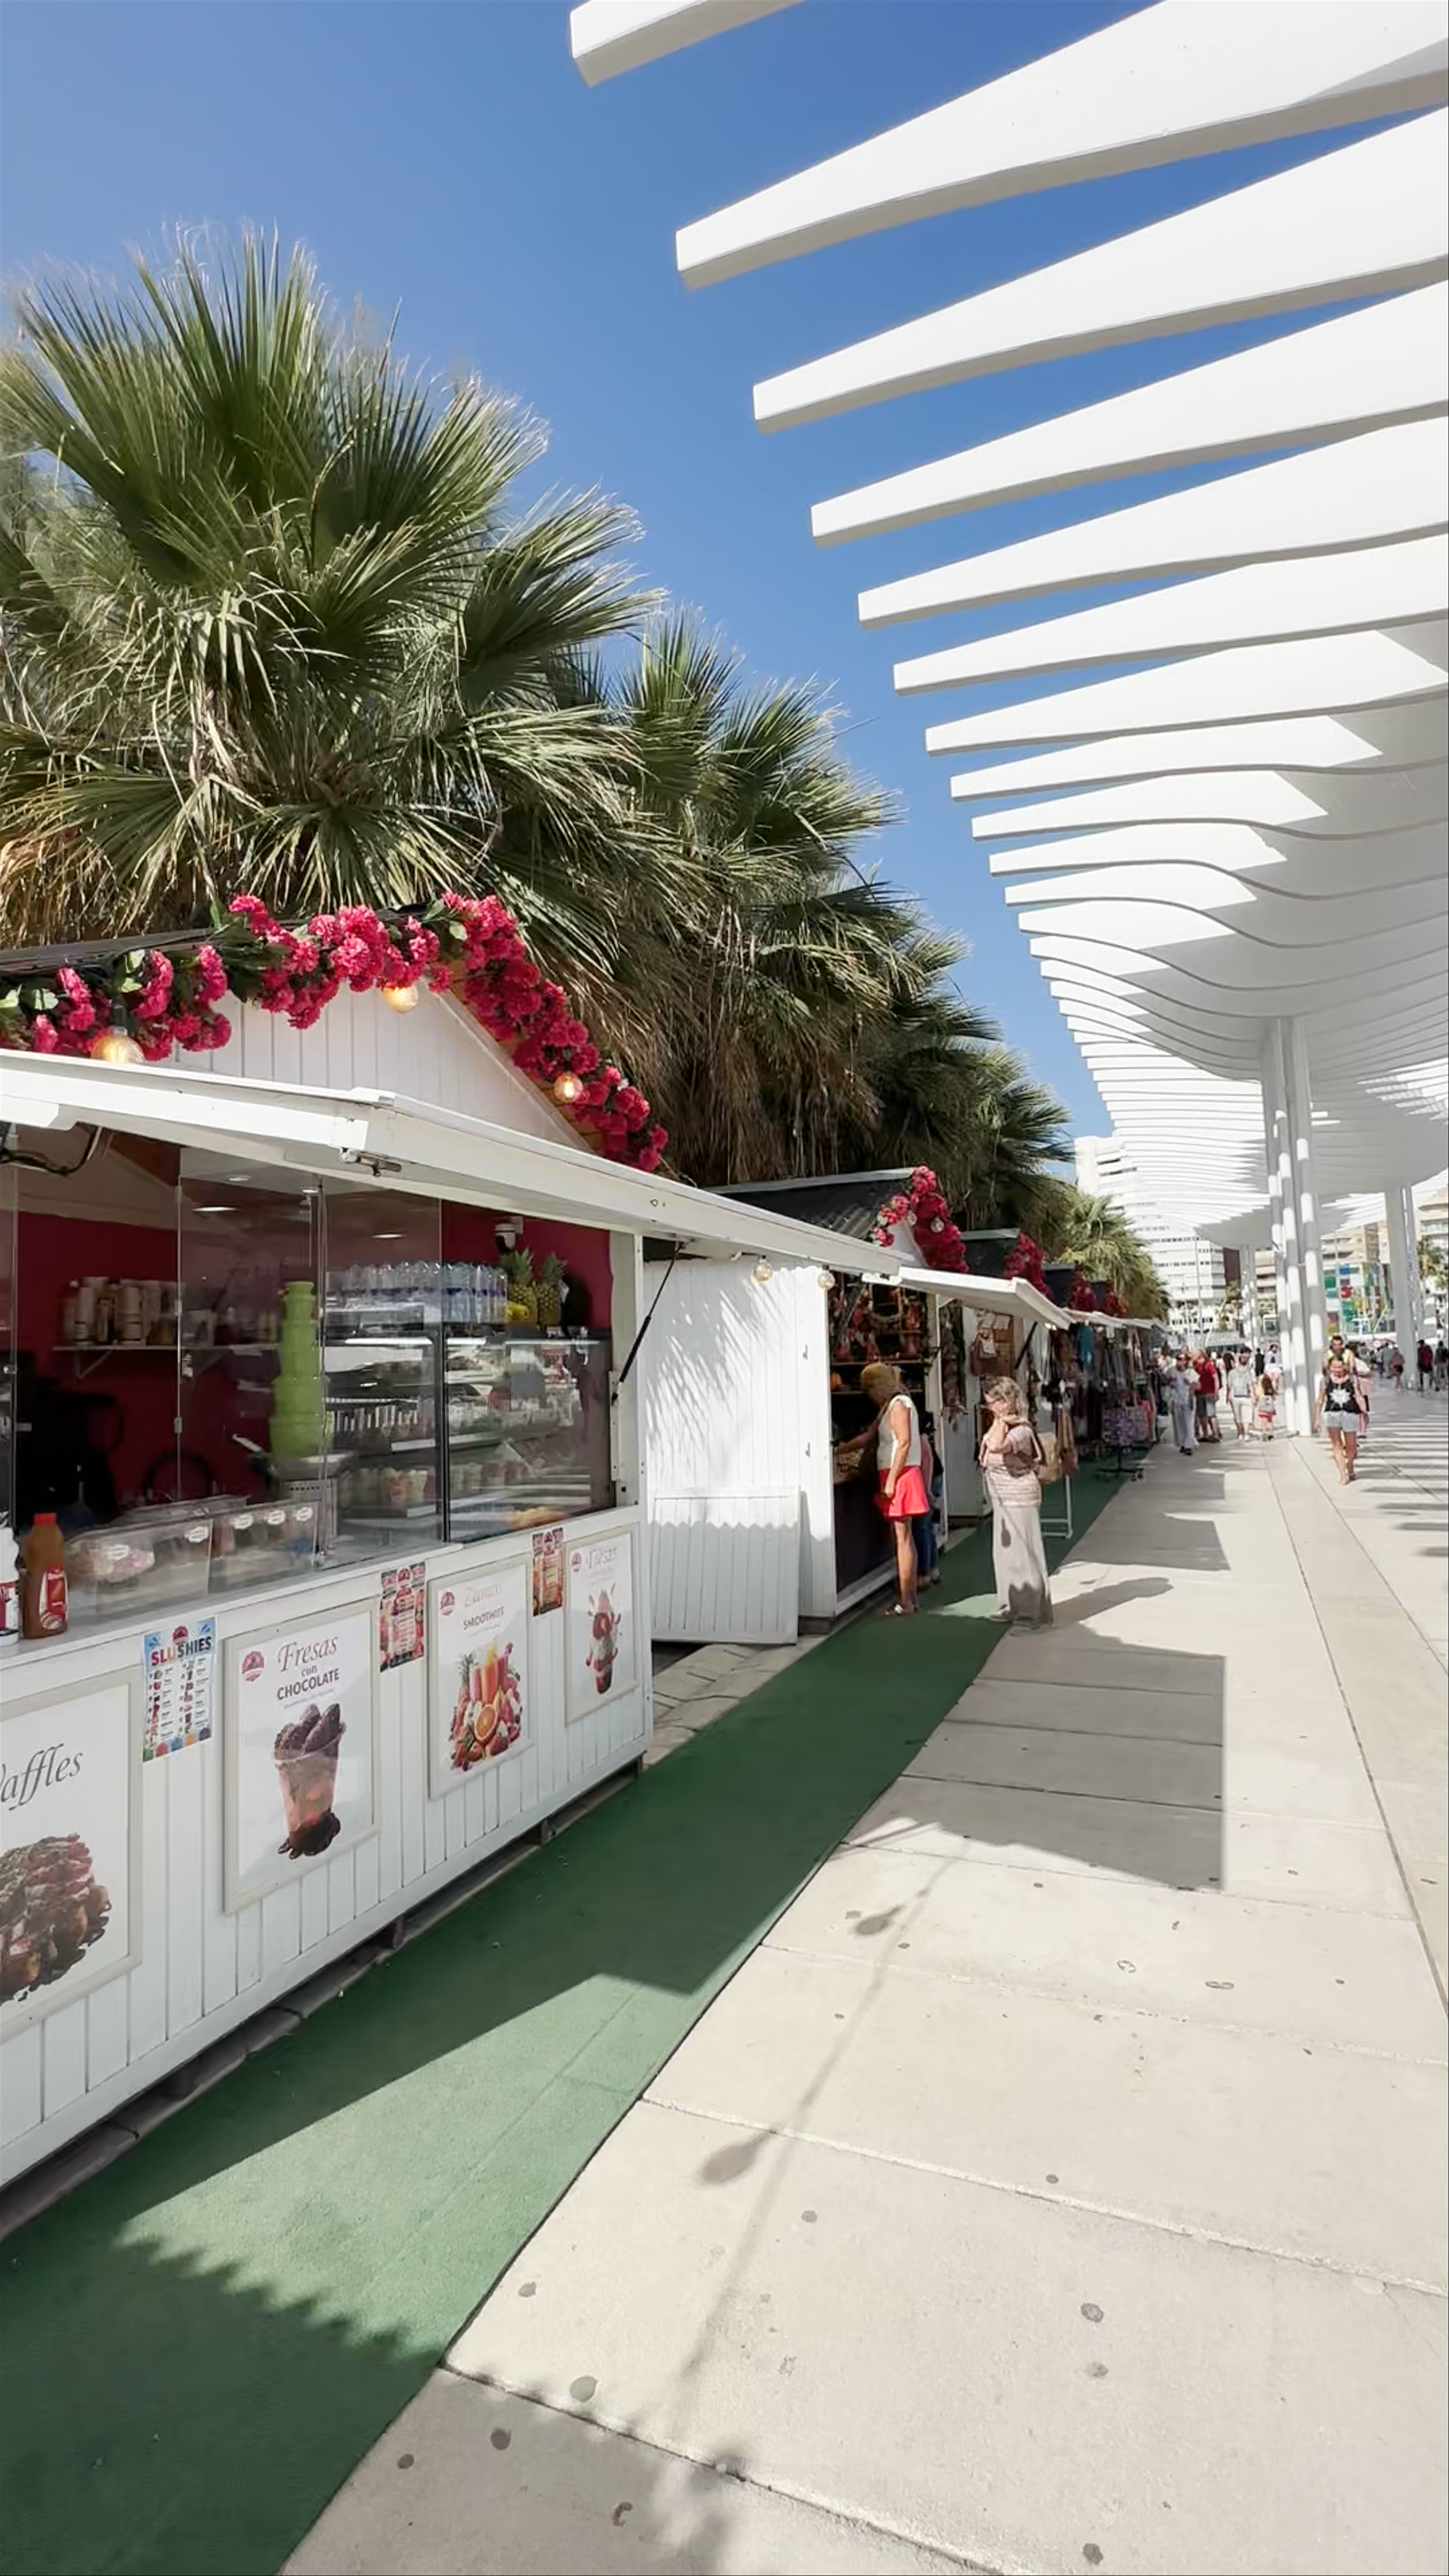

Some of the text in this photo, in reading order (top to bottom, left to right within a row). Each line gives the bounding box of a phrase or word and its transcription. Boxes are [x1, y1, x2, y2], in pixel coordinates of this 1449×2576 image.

[151, 1636, 211, 1666] SLUSHIES
[278, 1637, 338, 1672] Fresas
[277, 1668, 340, 1700] CHOCOLATE
[301, 1665, 317, 1677] con
